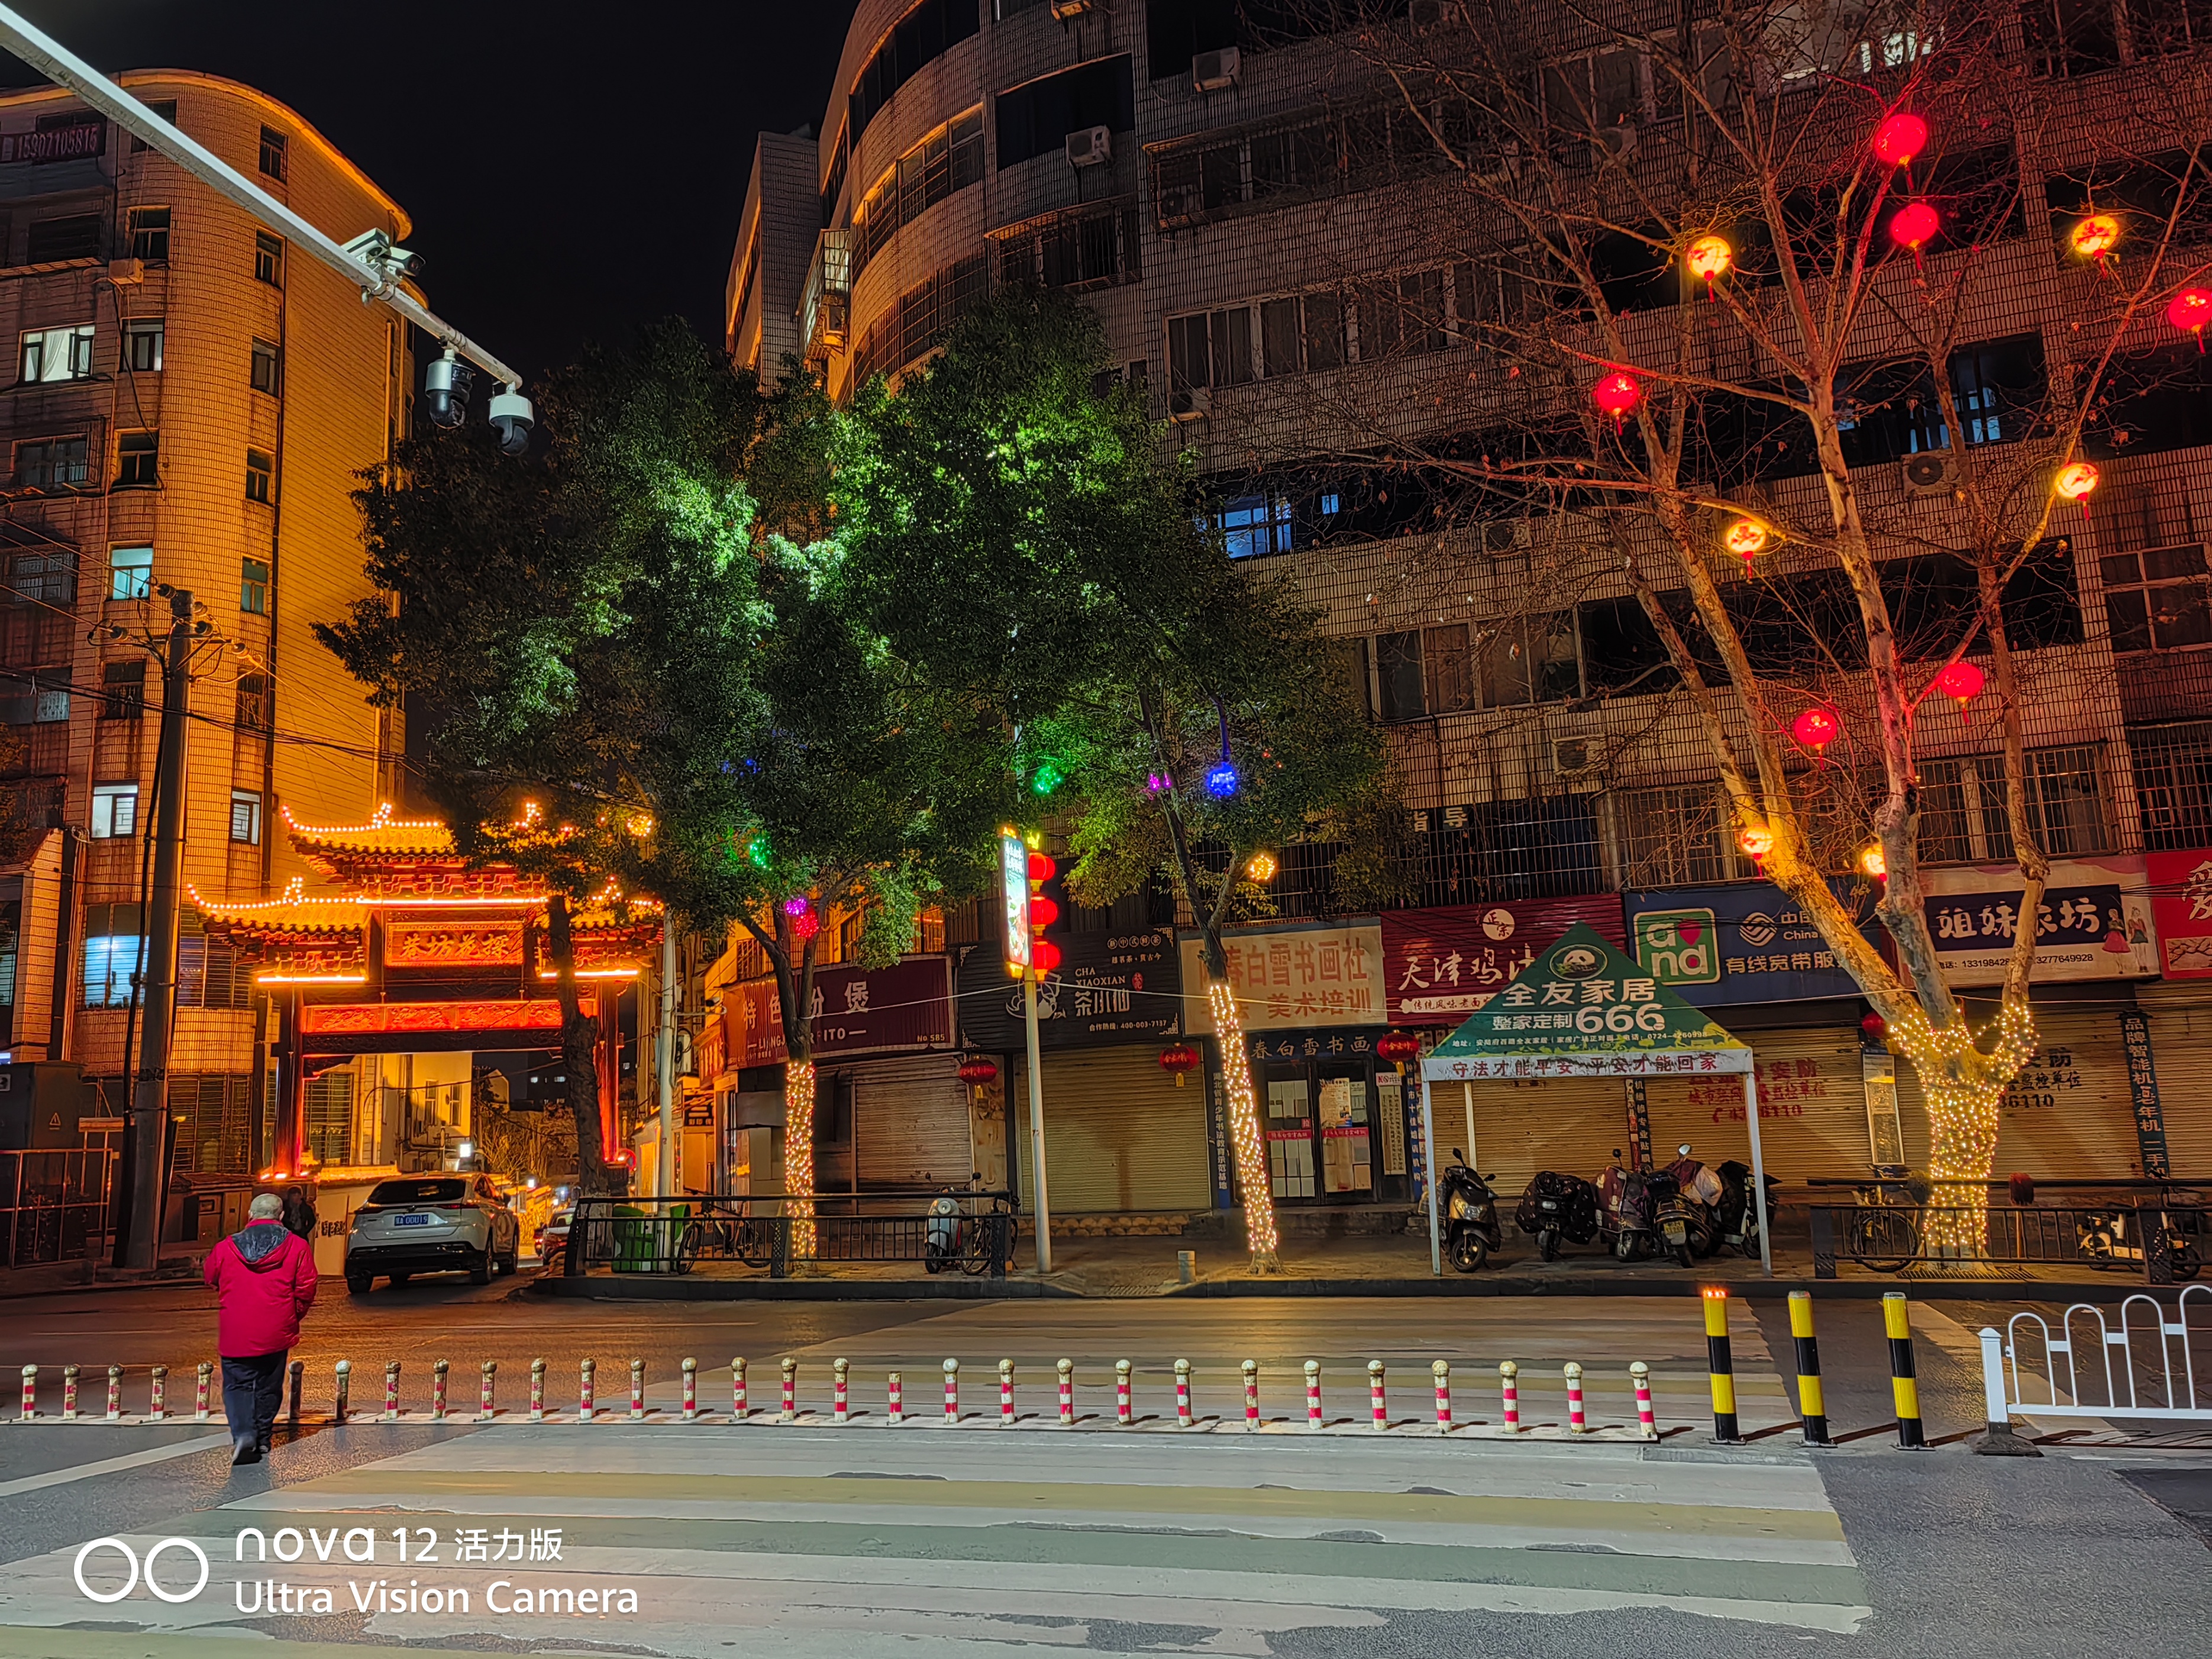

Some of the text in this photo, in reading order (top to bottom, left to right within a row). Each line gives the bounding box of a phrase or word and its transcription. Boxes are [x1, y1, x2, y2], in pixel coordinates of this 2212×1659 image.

[1783, 929, 1818, 940] China
[1075, 967, 1096, 977] CHA
[1199, 937, 1368, 990] 春白雪书画社
[1726, 951, 1840, 974] 有线宽带服
[1961, 957, 2010, 969] 133198428
[2037, 954, 2094, 965] 3277649928
[1076, 976, 1126, 987] XIAOXIAN
[1502, 978, 1656, 1007] 全友家居
[1075, 987, 1130, 1016] 茶小仙
[1268, 987, 1372, 1019] 美术培训
[1492, 1003, 1665, 1034] 整家定制 666
[929, 1033, 945, 1042] 585
[1452, 1054, 1717, 1078] 守法才能平安 平安才能回家
